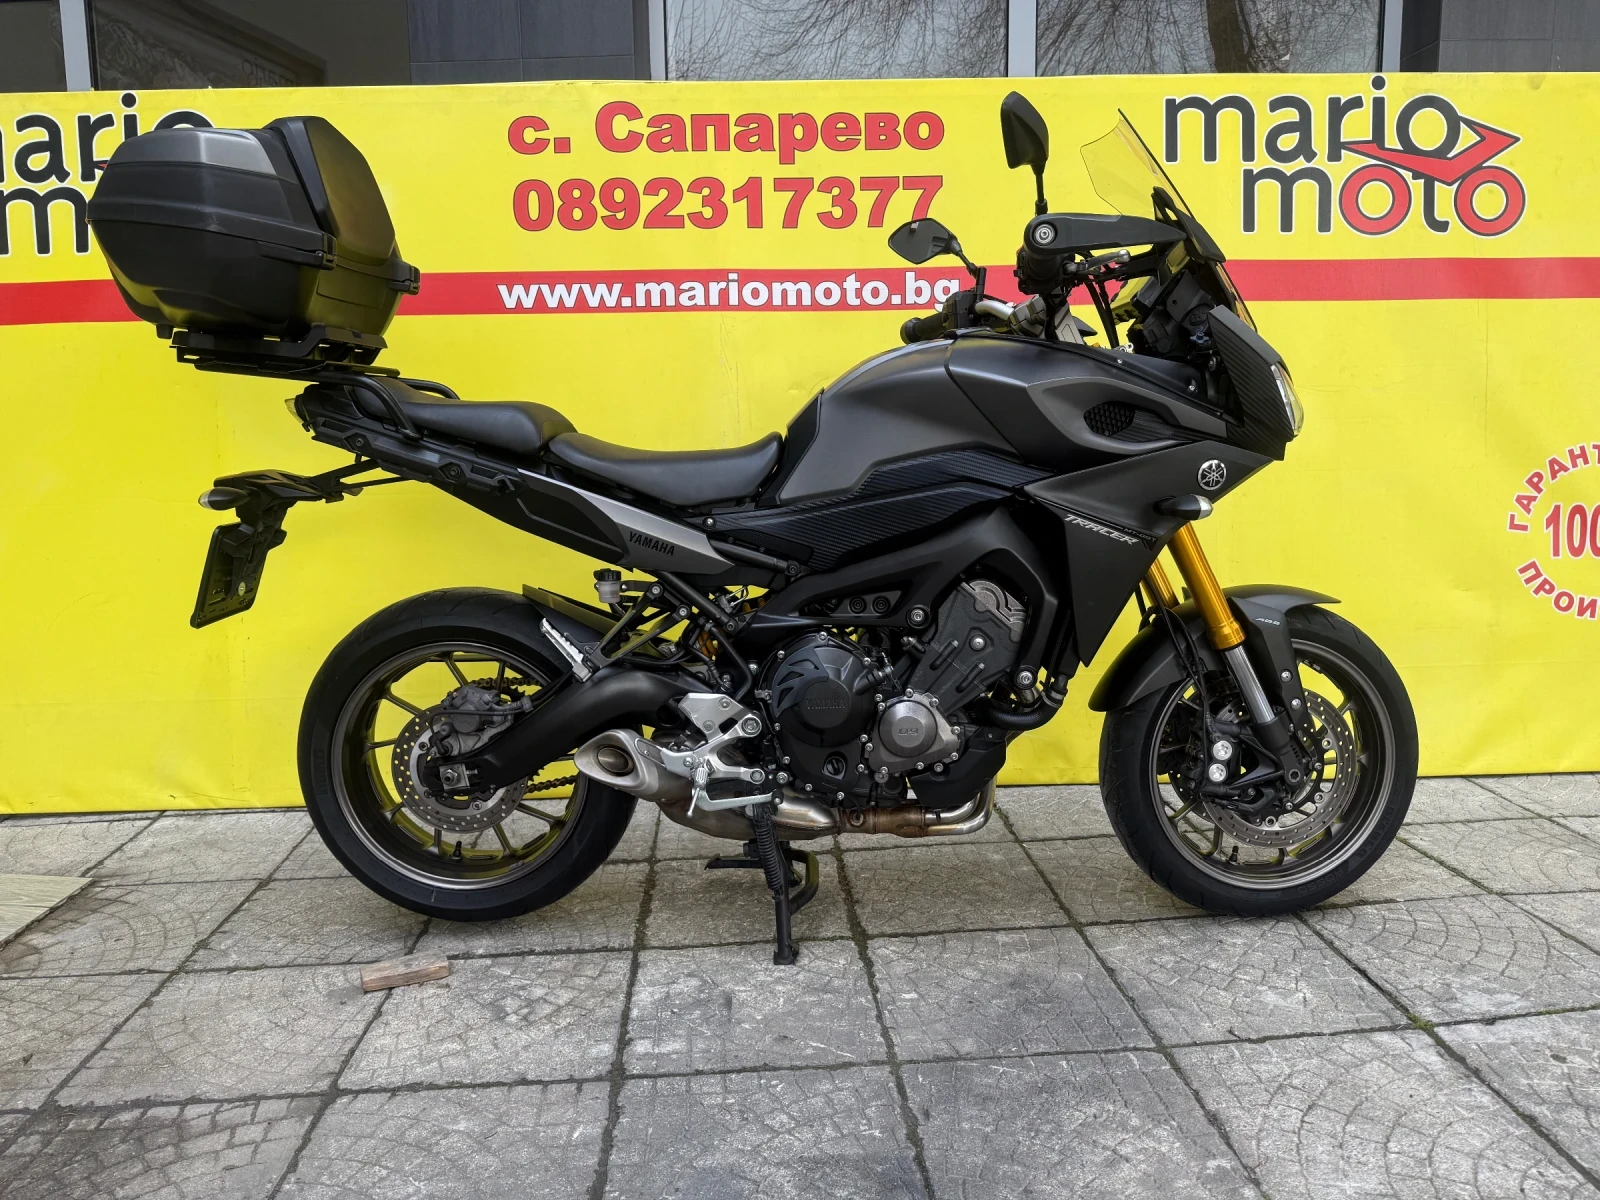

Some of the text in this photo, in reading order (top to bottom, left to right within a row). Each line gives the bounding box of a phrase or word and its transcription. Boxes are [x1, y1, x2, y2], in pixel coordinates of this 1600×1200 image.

[0, 91, 214, 184] ari
[507, 100, 945, 165] с. Сапарево
[1164, 74, 1462, 163] mario
[513, 174, 943, 231] 0892317377
[1242, 164, 1526, 236] moto
[497, 271, 960, 312] www.mariomoto.bg
[628, 531, 675, 556] YAMAHA
[1064, 514, 1139, 546] TRACER
